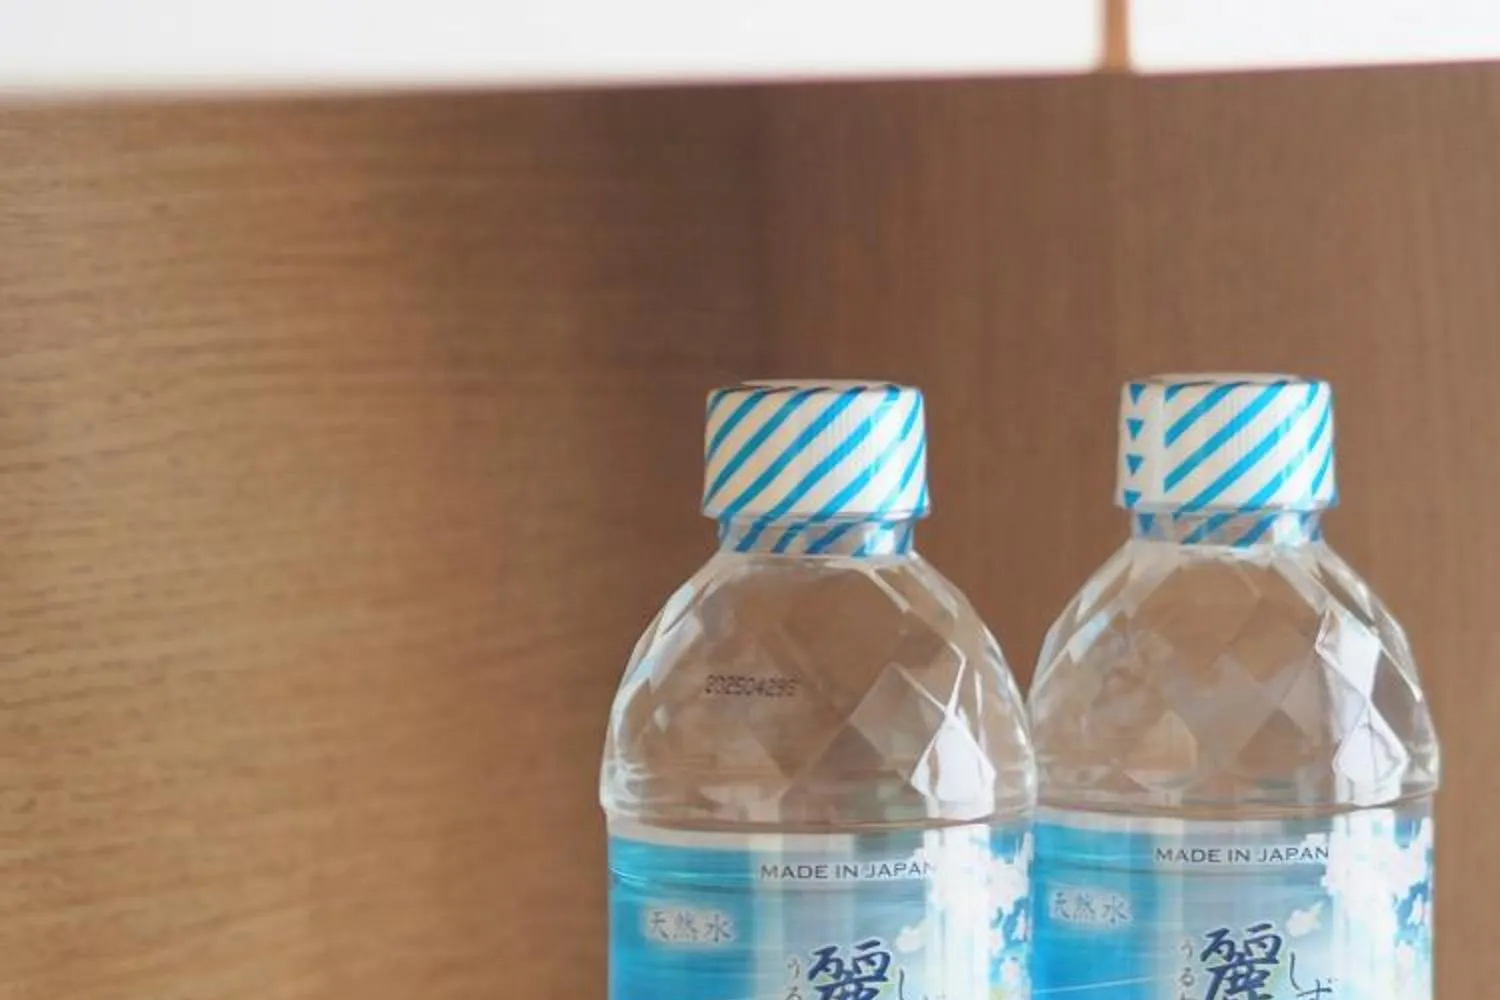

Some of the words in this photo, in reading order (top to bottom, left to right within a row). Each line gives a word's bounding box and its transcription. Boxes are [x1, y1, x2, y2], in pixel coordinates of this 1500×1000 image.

[1156, 847, 1222, 864] MADE
[1227, 847, 1251, 863] IN
[1257, 846, 1330, 862] JAPAN
[760, 863, 829, 880] MADE
[834, 865, 860, 880] IN
[864, 862, 937, 879] JAPAN
[1055, 891, 1129, 924] 天然水
[648, 909, 732, 942] 天然水
